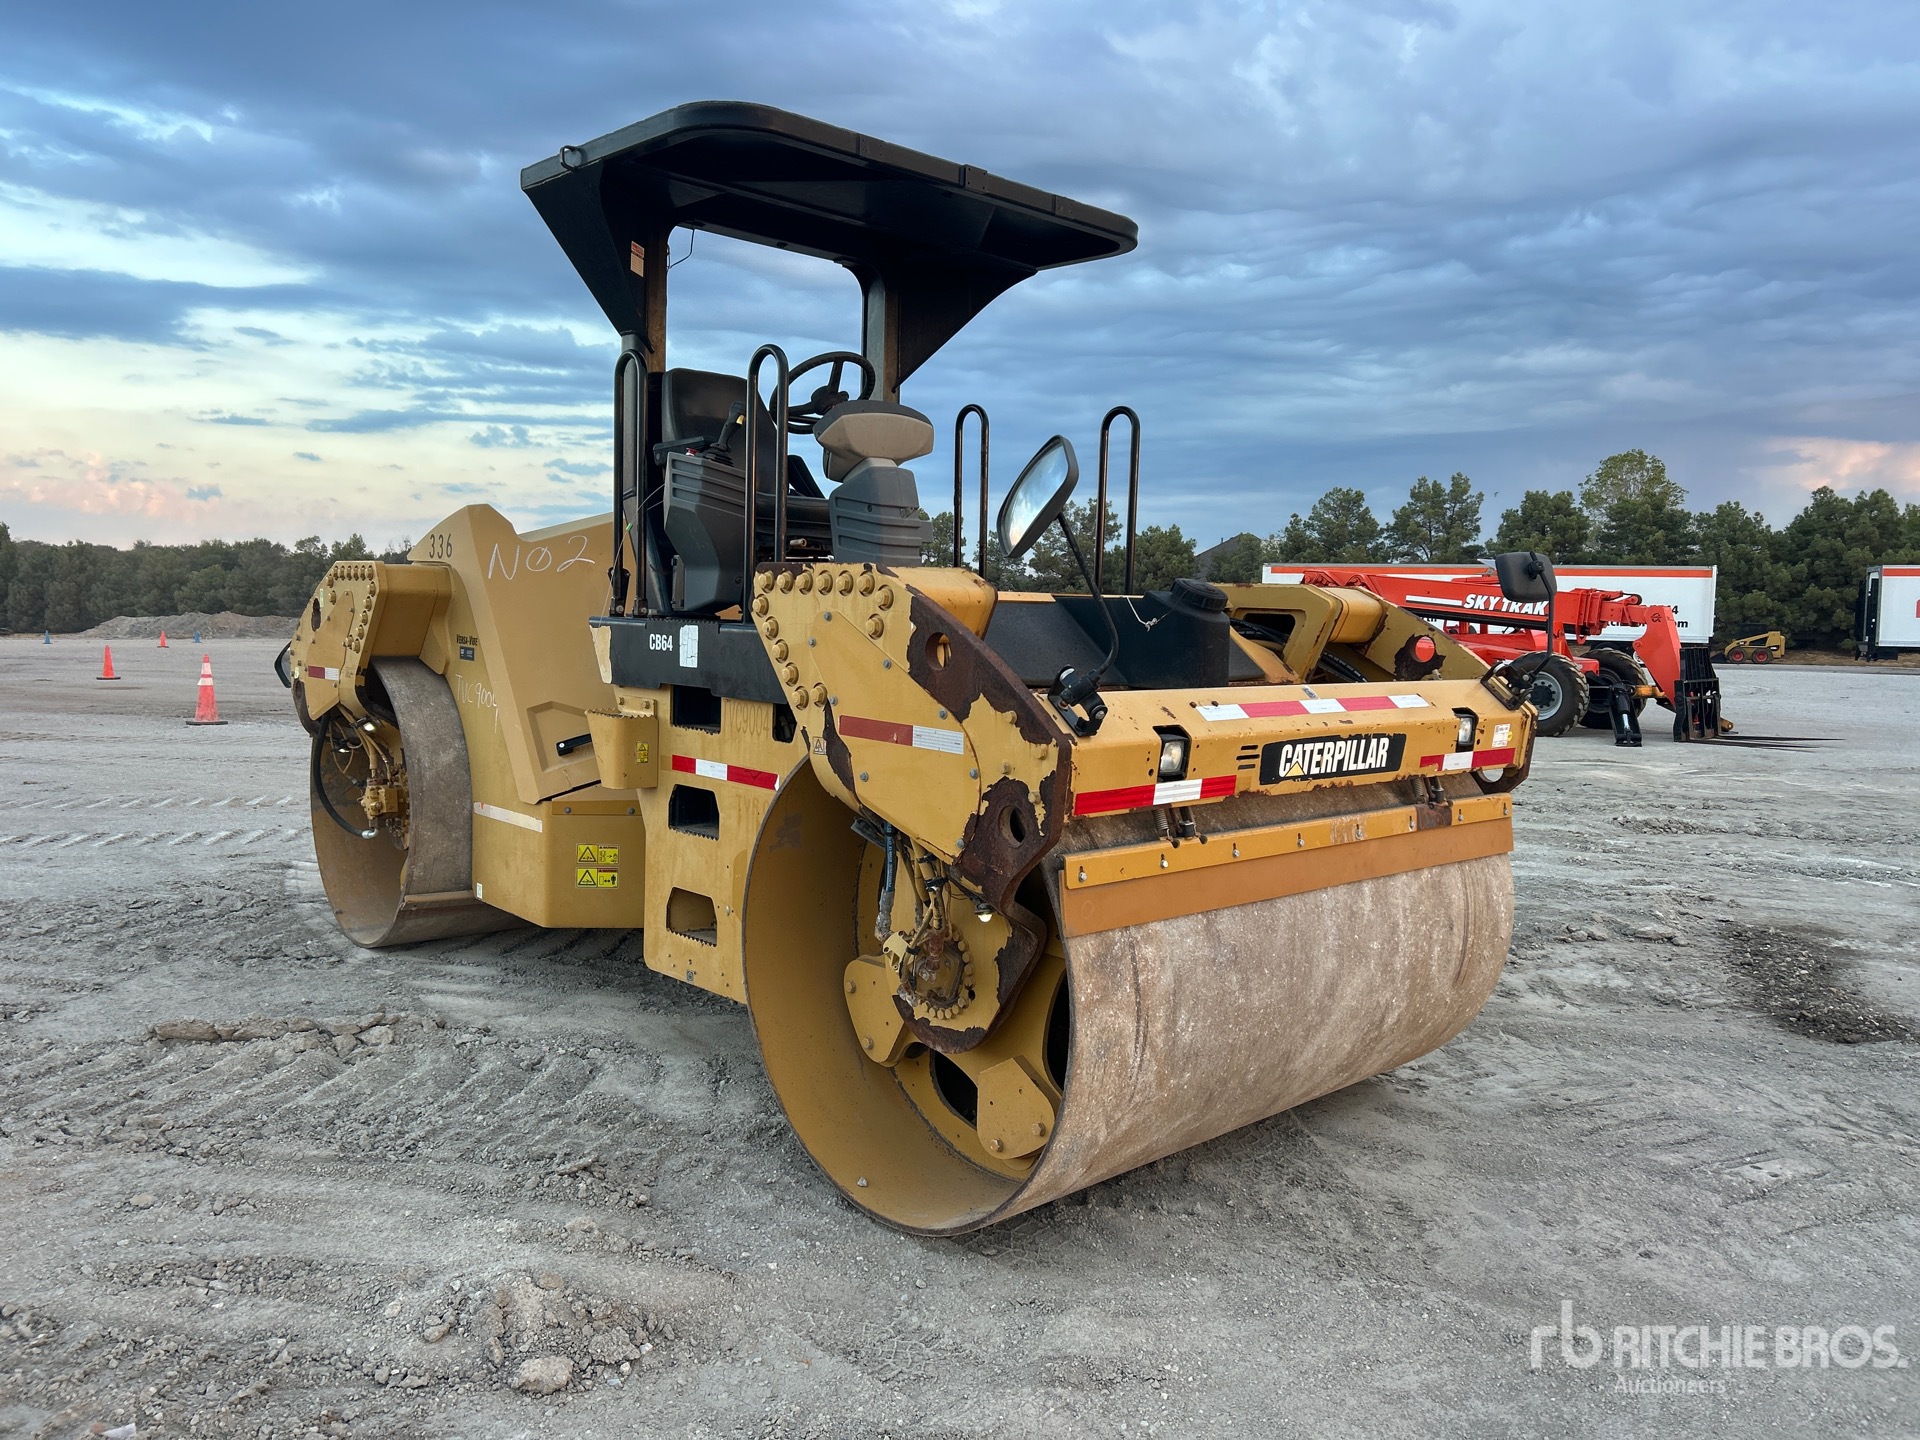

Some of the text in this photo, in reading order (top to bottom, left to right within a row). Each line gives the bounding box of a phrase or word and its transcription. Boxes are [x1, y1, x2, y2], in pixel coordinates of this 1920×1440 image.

[428, 533, 453, 559] 336
[649, 633, 673, 652] CB64
[1278, 737, 1390, 778] CATERPILLAR
